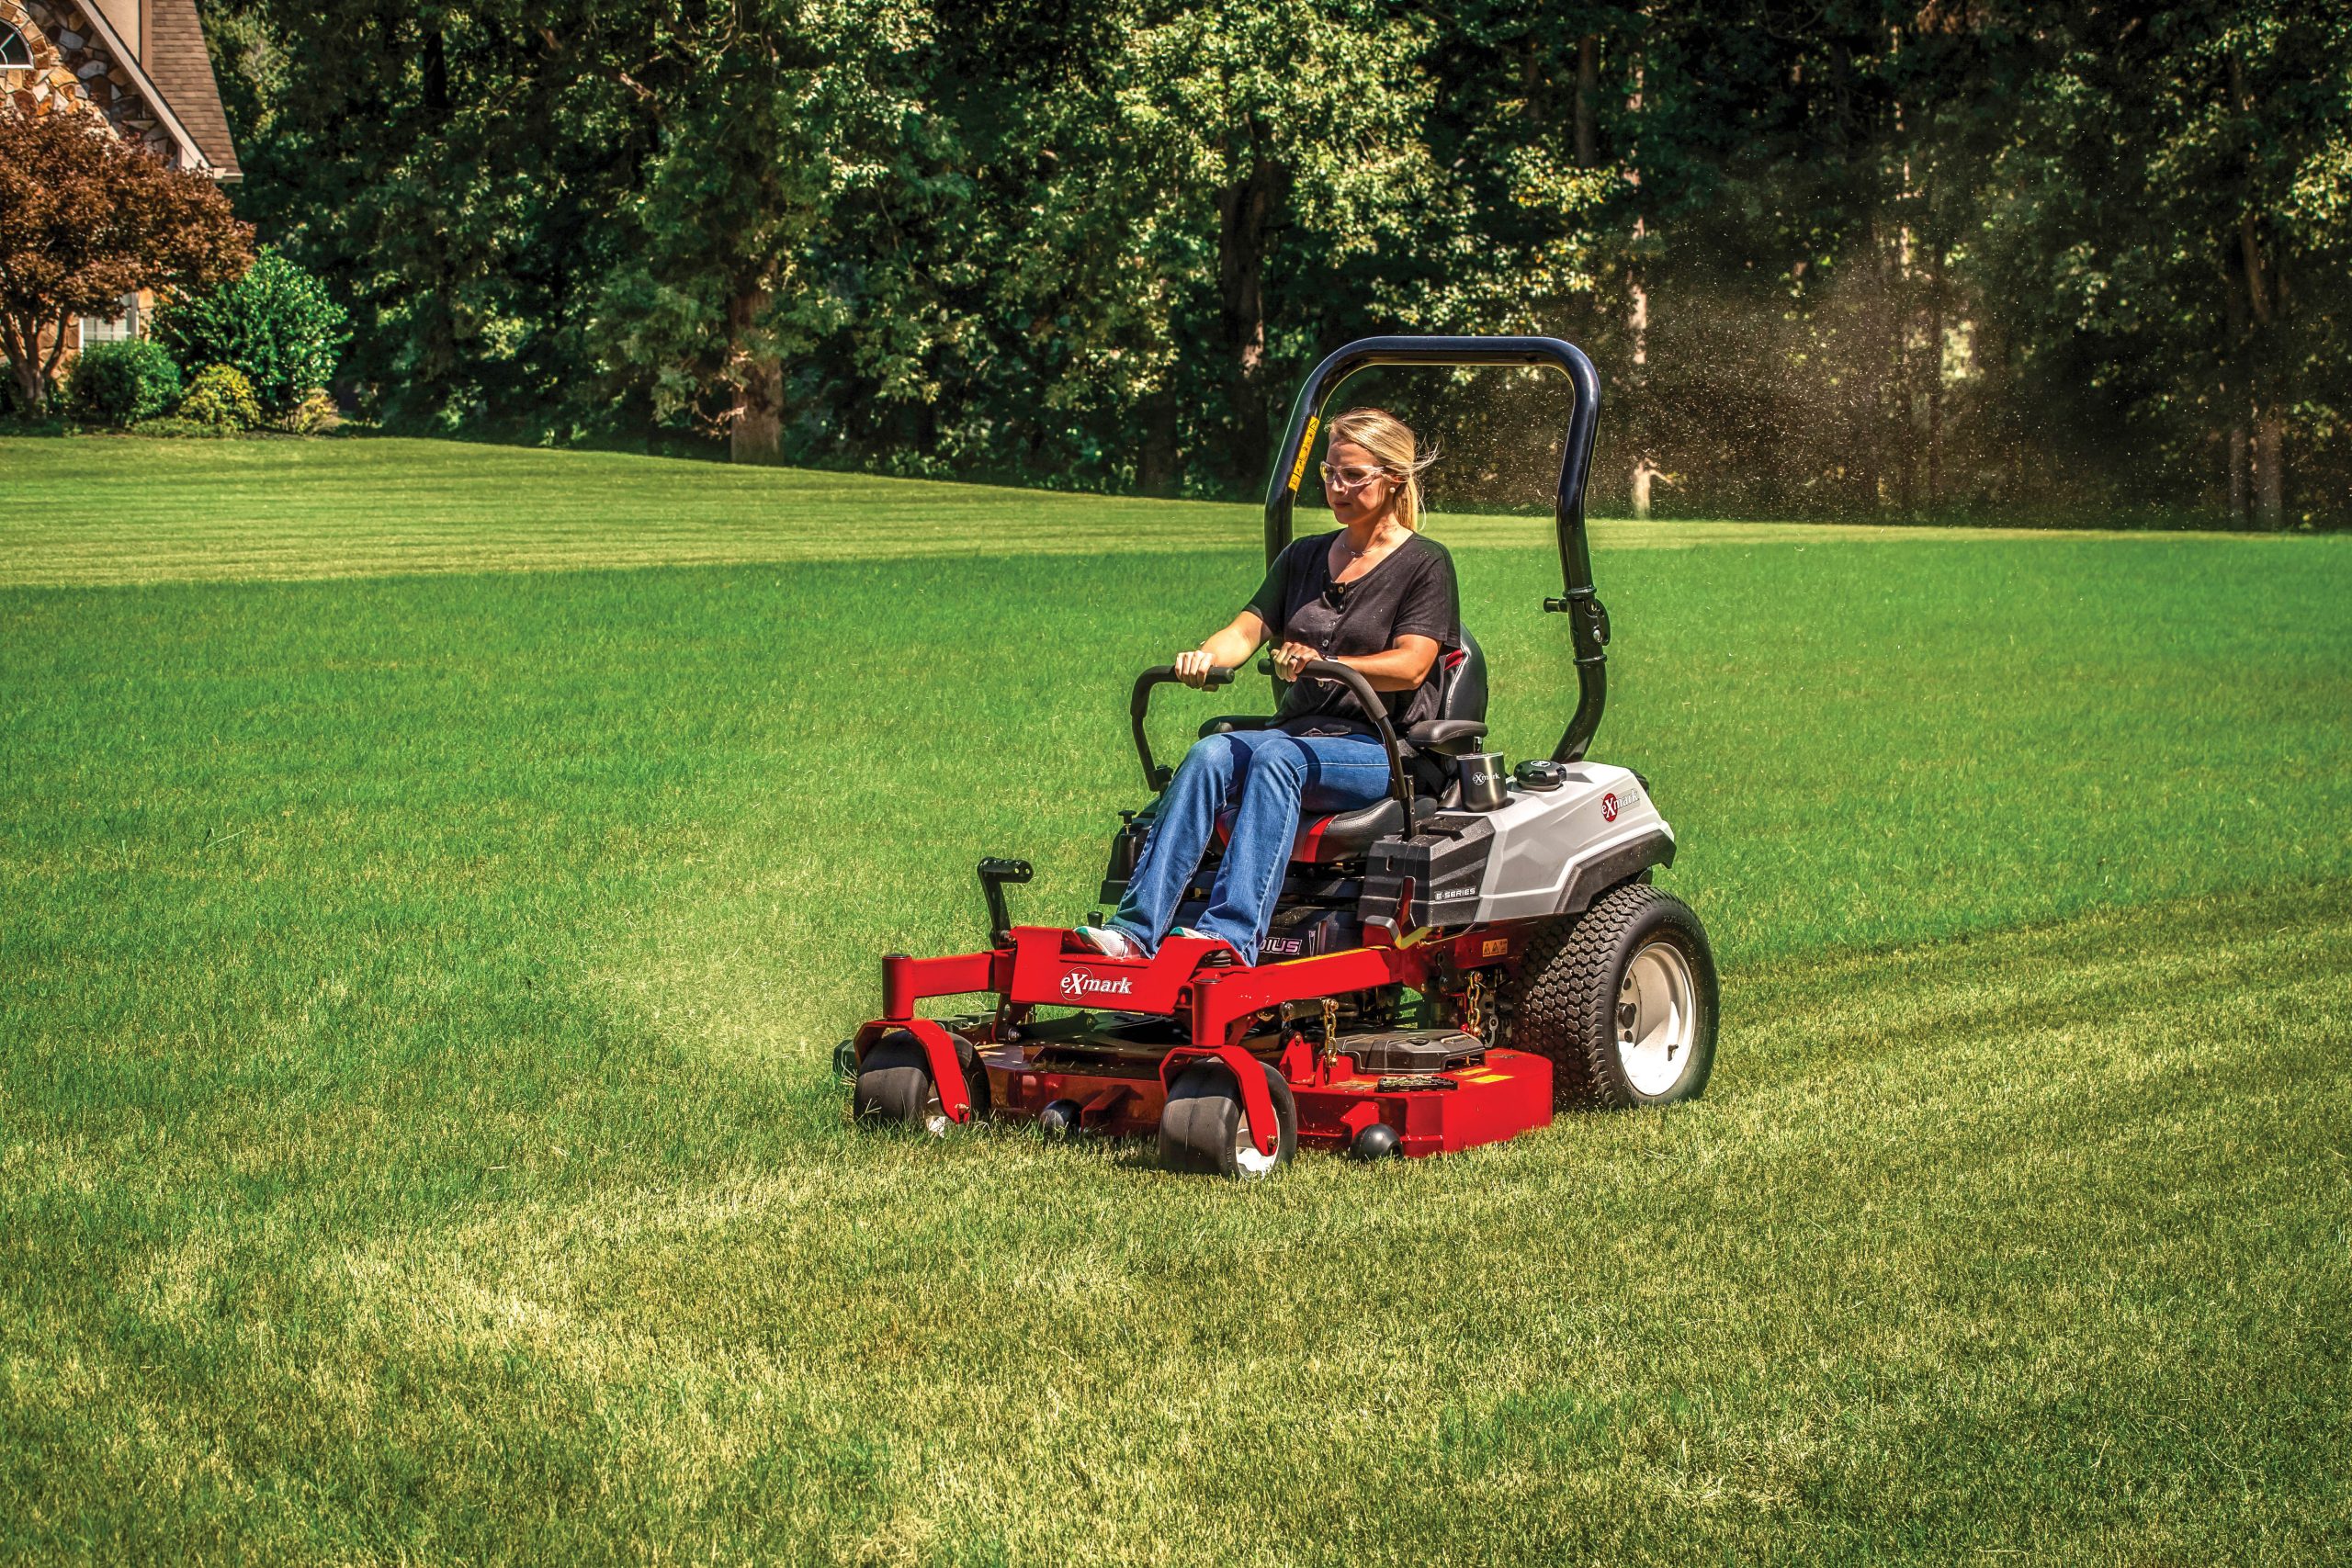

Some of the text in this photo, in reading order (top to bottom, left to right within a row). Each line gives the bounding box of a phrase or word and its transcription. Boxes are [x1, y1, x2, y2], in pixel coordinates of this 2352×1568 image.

[1601, 790, 1639, 818] eXmark
[1436, 887, 1476, 899] E-SERIES
[1259, 938, 1301, 953] DIUS
[1061, 973, 1133, 995] eXmark
